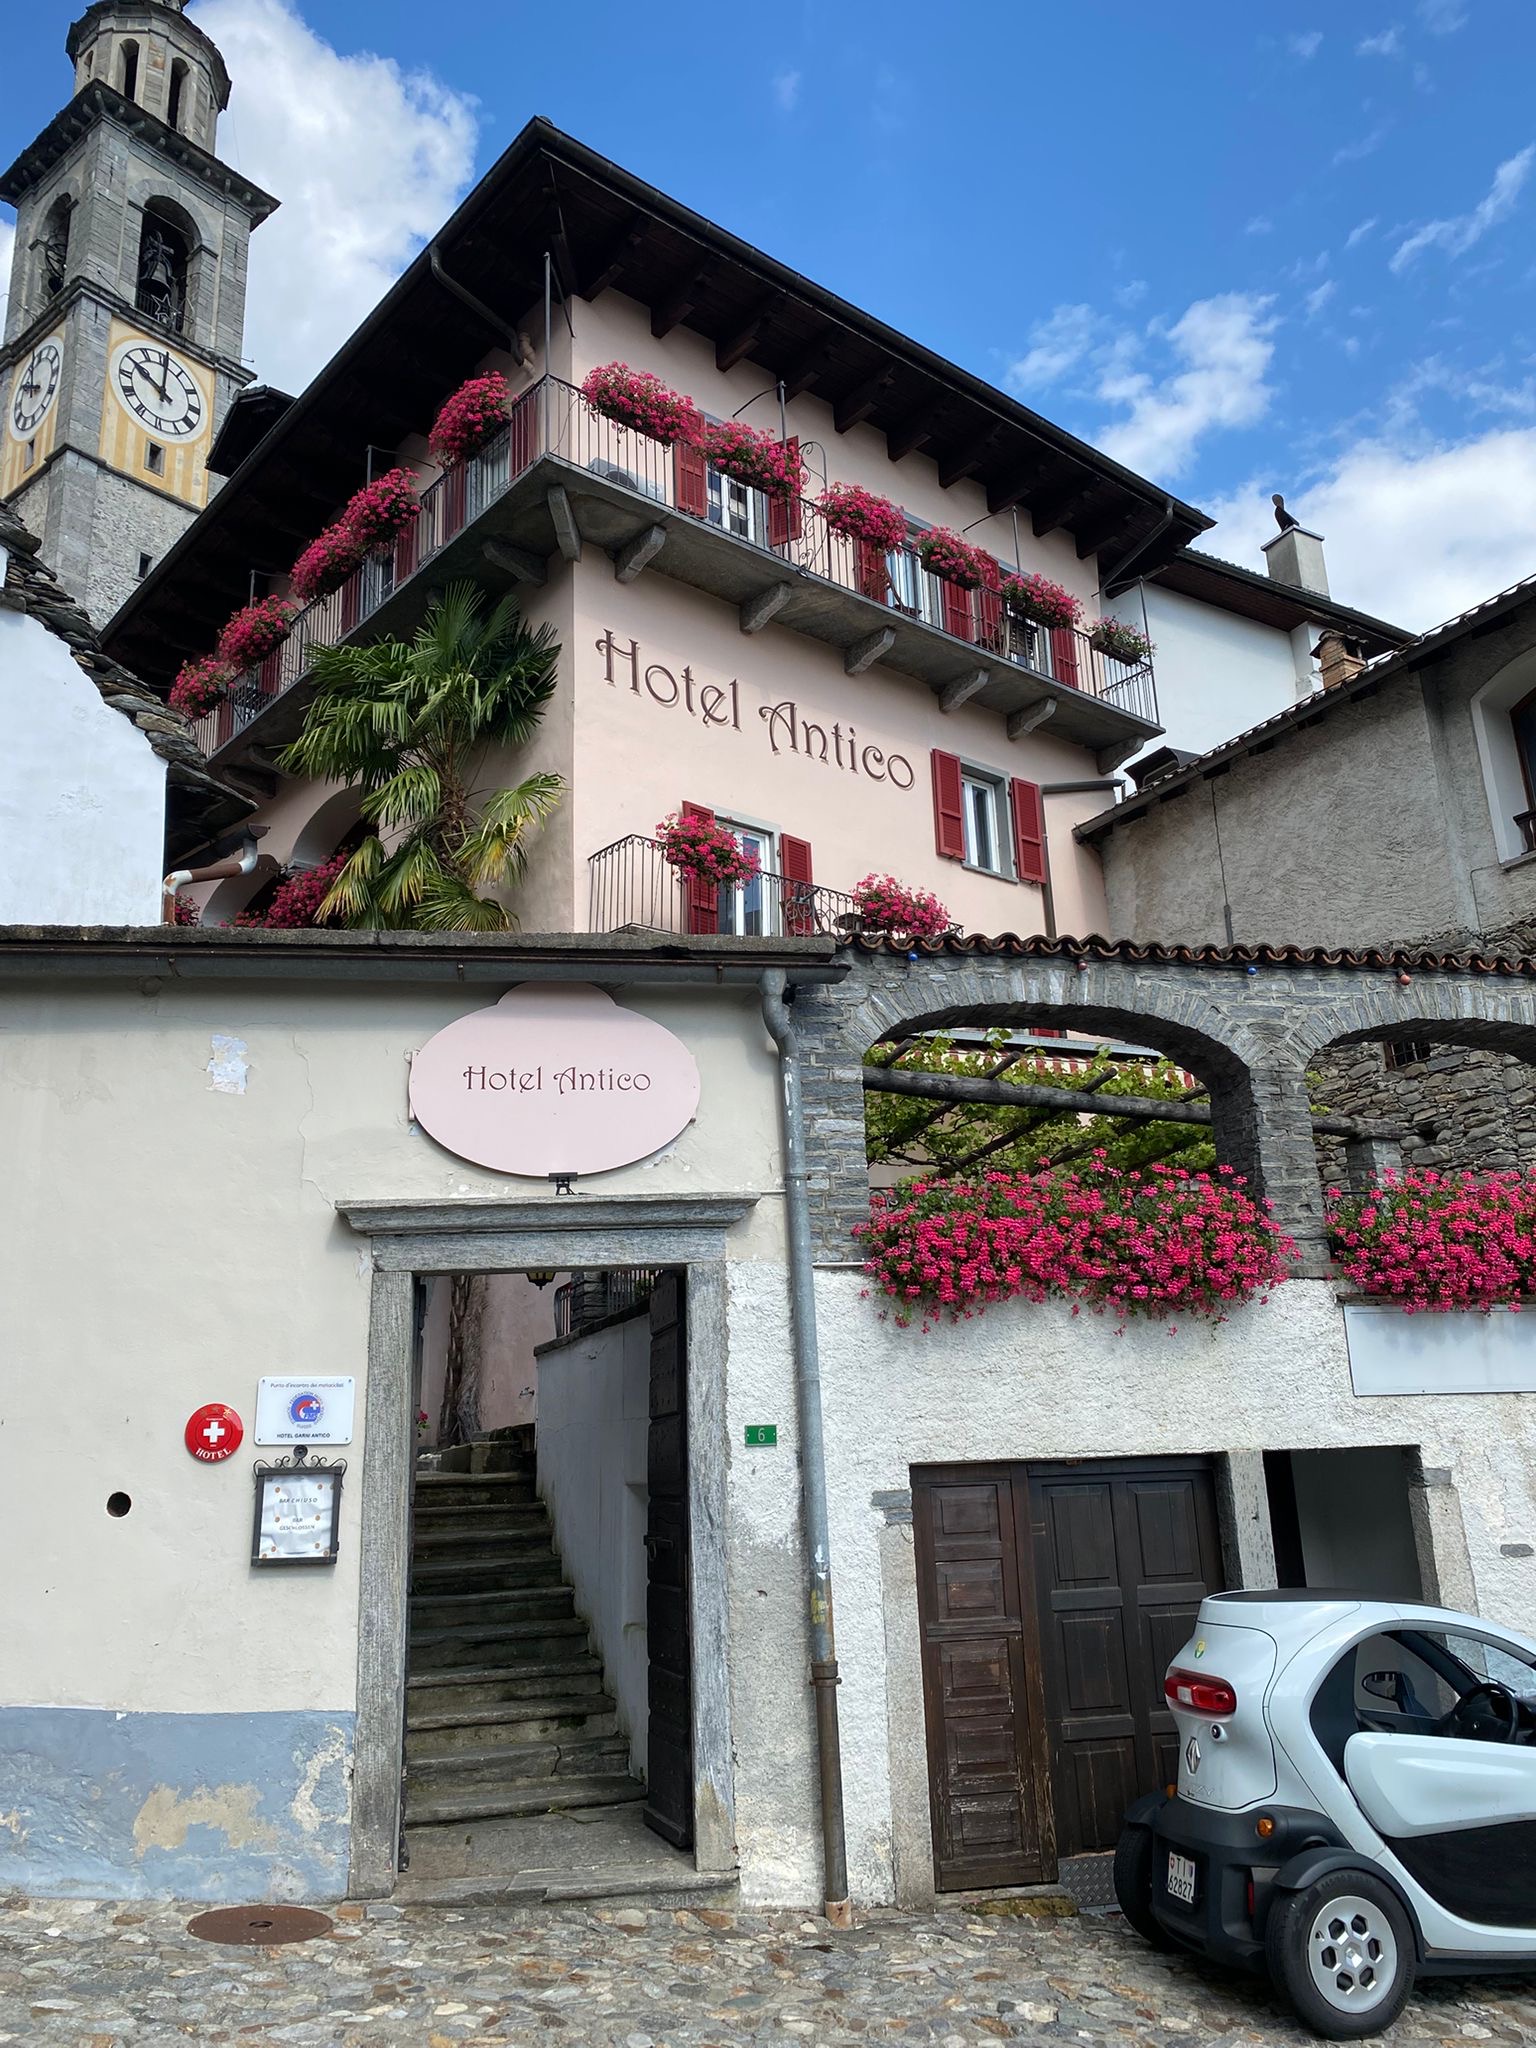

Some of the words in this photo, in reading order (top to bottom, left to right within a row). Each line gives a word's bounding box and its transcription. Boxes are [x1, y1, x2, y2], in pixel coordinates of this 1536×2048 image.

[595, 628, 742, 732] Hotel
[758, 701, 915, 790] Antico
[463, 1066, 543, 1094] Hotel
[553, 1066, 652, 1095] Antico
[757, 1427, 766, 1442] 6
[195, 1448, 232, 1460] HOTEL
[1168, 1875, 1193, 1900] 62827
